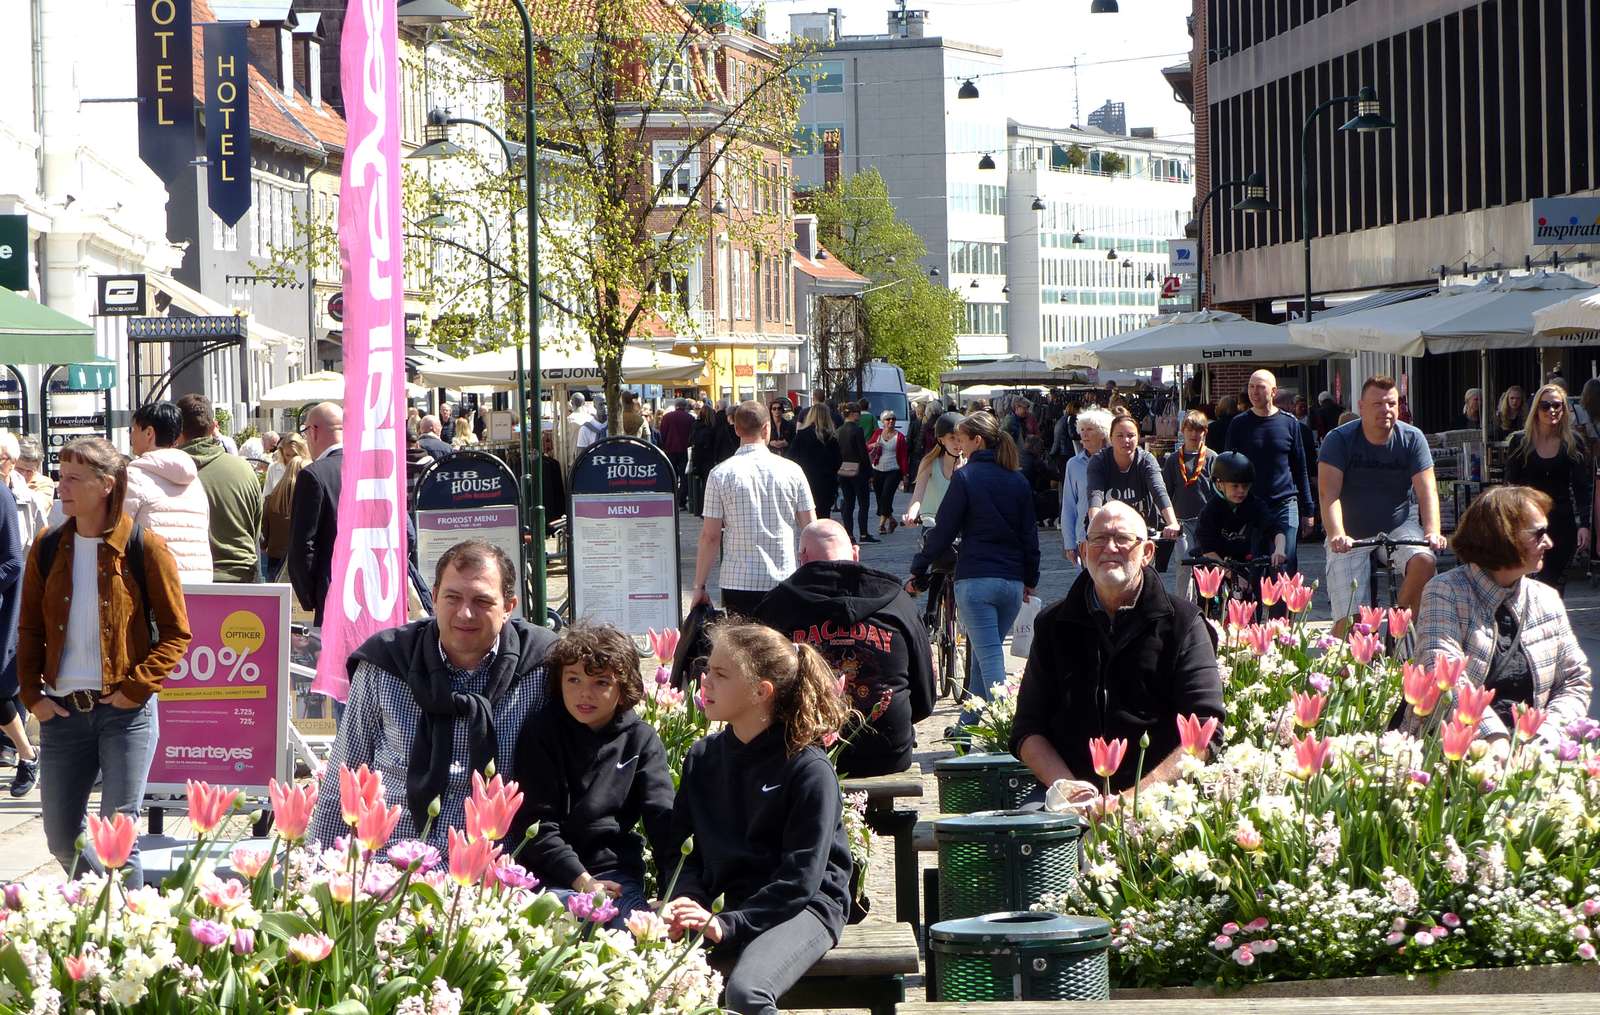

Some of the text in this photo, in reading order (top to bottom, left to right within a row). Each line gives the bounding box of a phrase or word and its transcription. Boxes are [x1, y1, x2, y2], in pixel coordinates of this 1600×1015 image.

[217, 55, 237, 181] HOTEL
[1202, 348, 1253, 358] bahne
[592, 455, 635, 466] RIB
[436, 470, 479, 482] RIB
[607, 464, 657, 479] HOUSE
[452, 476, 502, 494] HOUSE
[607, 505, 640, 515] MENU
[437, 514, 498, 525] FROKOST MENU
[225, 631, 261, 640] OPTIKER
[165, 745, 253, 762] smarteyes
